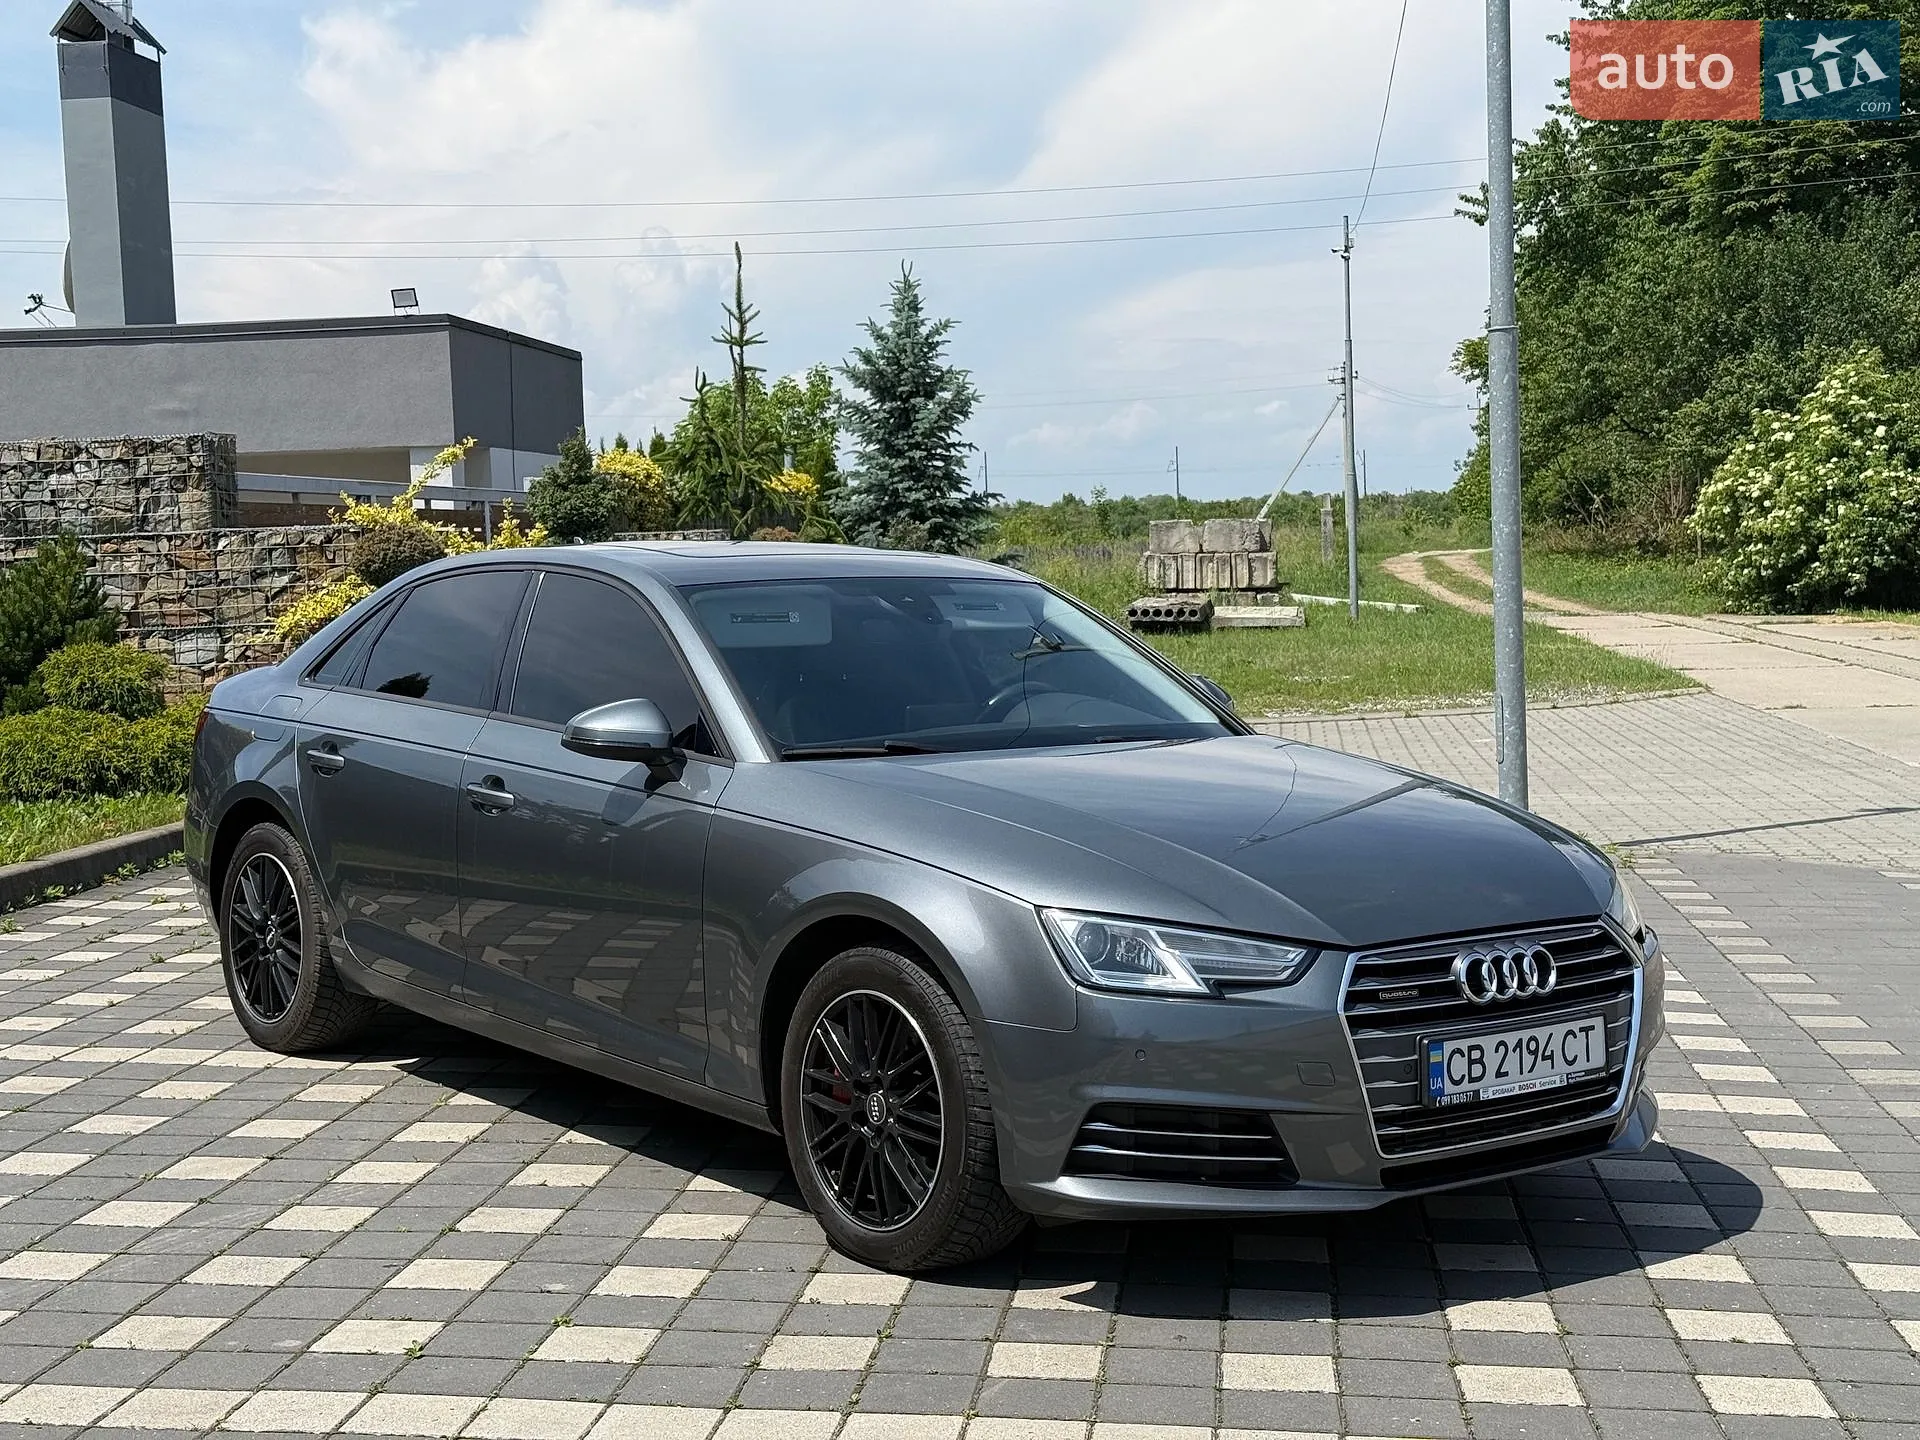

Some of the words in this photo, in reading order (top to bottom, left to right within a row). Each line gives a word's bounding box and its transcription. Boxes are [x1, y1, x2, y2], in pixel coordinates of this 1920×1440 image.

[1382, 990, 1418, 999] quattro
[1446, 1043, 1487, 1086] CB
[1494, 1032, 1555, 1079] 2194
[1561, 1025, 1596, 1066] CT
[1430, 1077, 1443, 1090] UA
[1518, 1081, 1537, 1092] BOSCH
[1539, 1079, 1557, 1089] Service
